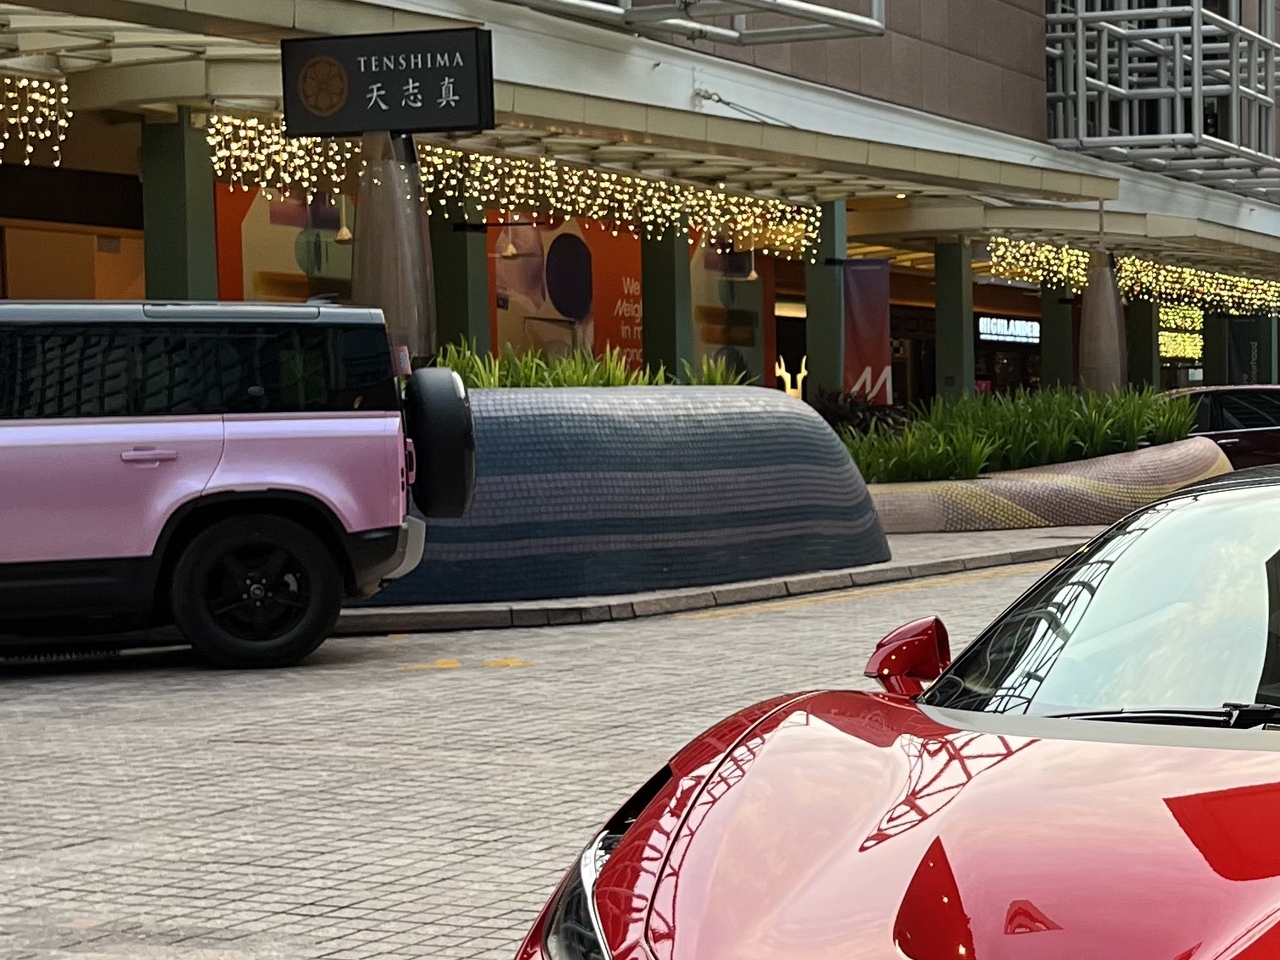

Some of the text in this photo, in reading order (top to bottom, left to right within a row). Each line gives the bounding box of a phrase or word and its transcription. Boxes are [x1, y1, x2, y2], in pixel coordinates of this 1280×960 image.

[357, 51, 464, 73] TENSHIMA
[621, 320, 631, 340] in
[979, 317, 1041, 338] HIGHLANDER
